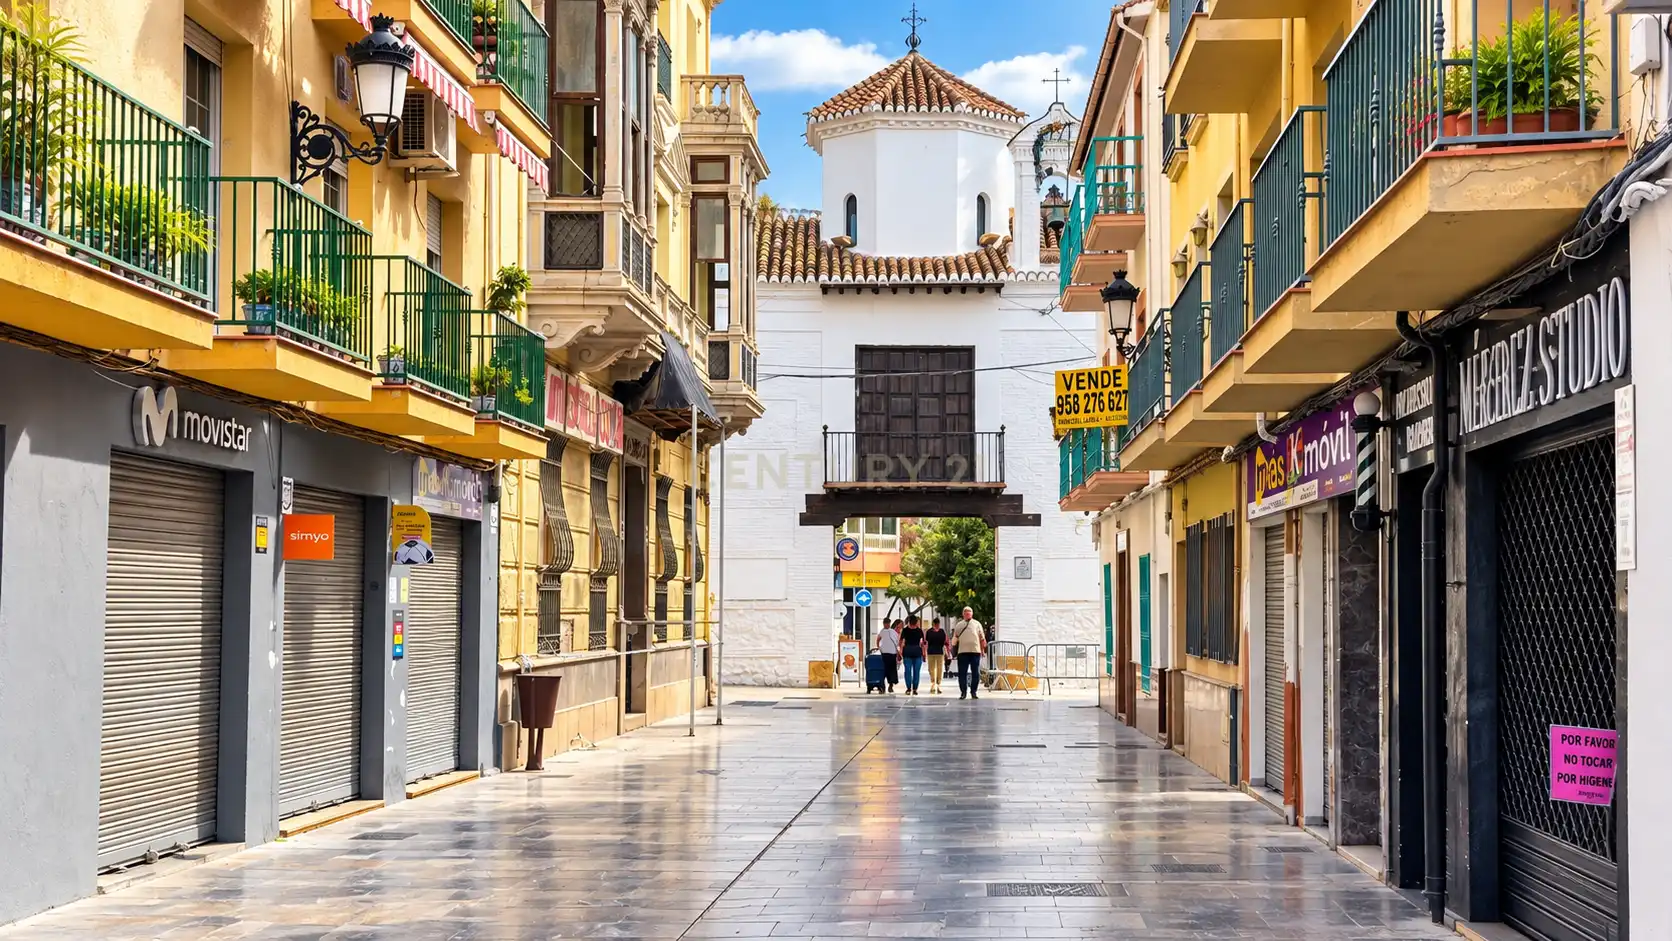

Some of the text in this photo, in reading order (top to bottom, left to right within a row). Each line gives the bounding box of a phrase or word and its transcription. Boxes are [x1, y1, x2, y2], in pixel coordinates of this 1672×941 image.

[1539, 276, 1627, 405] STUDIO
[1062, 369, 1122, 391] VENDE
[1057, 390, 1128, 416] 958 276 627
[184, 410, 252, 452] movistar
[290, 530, 329, 543] simyo
[1561, 734, 1615, 748] POR FAVOR
[1564, 754, 1613, 768] NO TOCAR
[1557, 773, 1577, 784] POR
